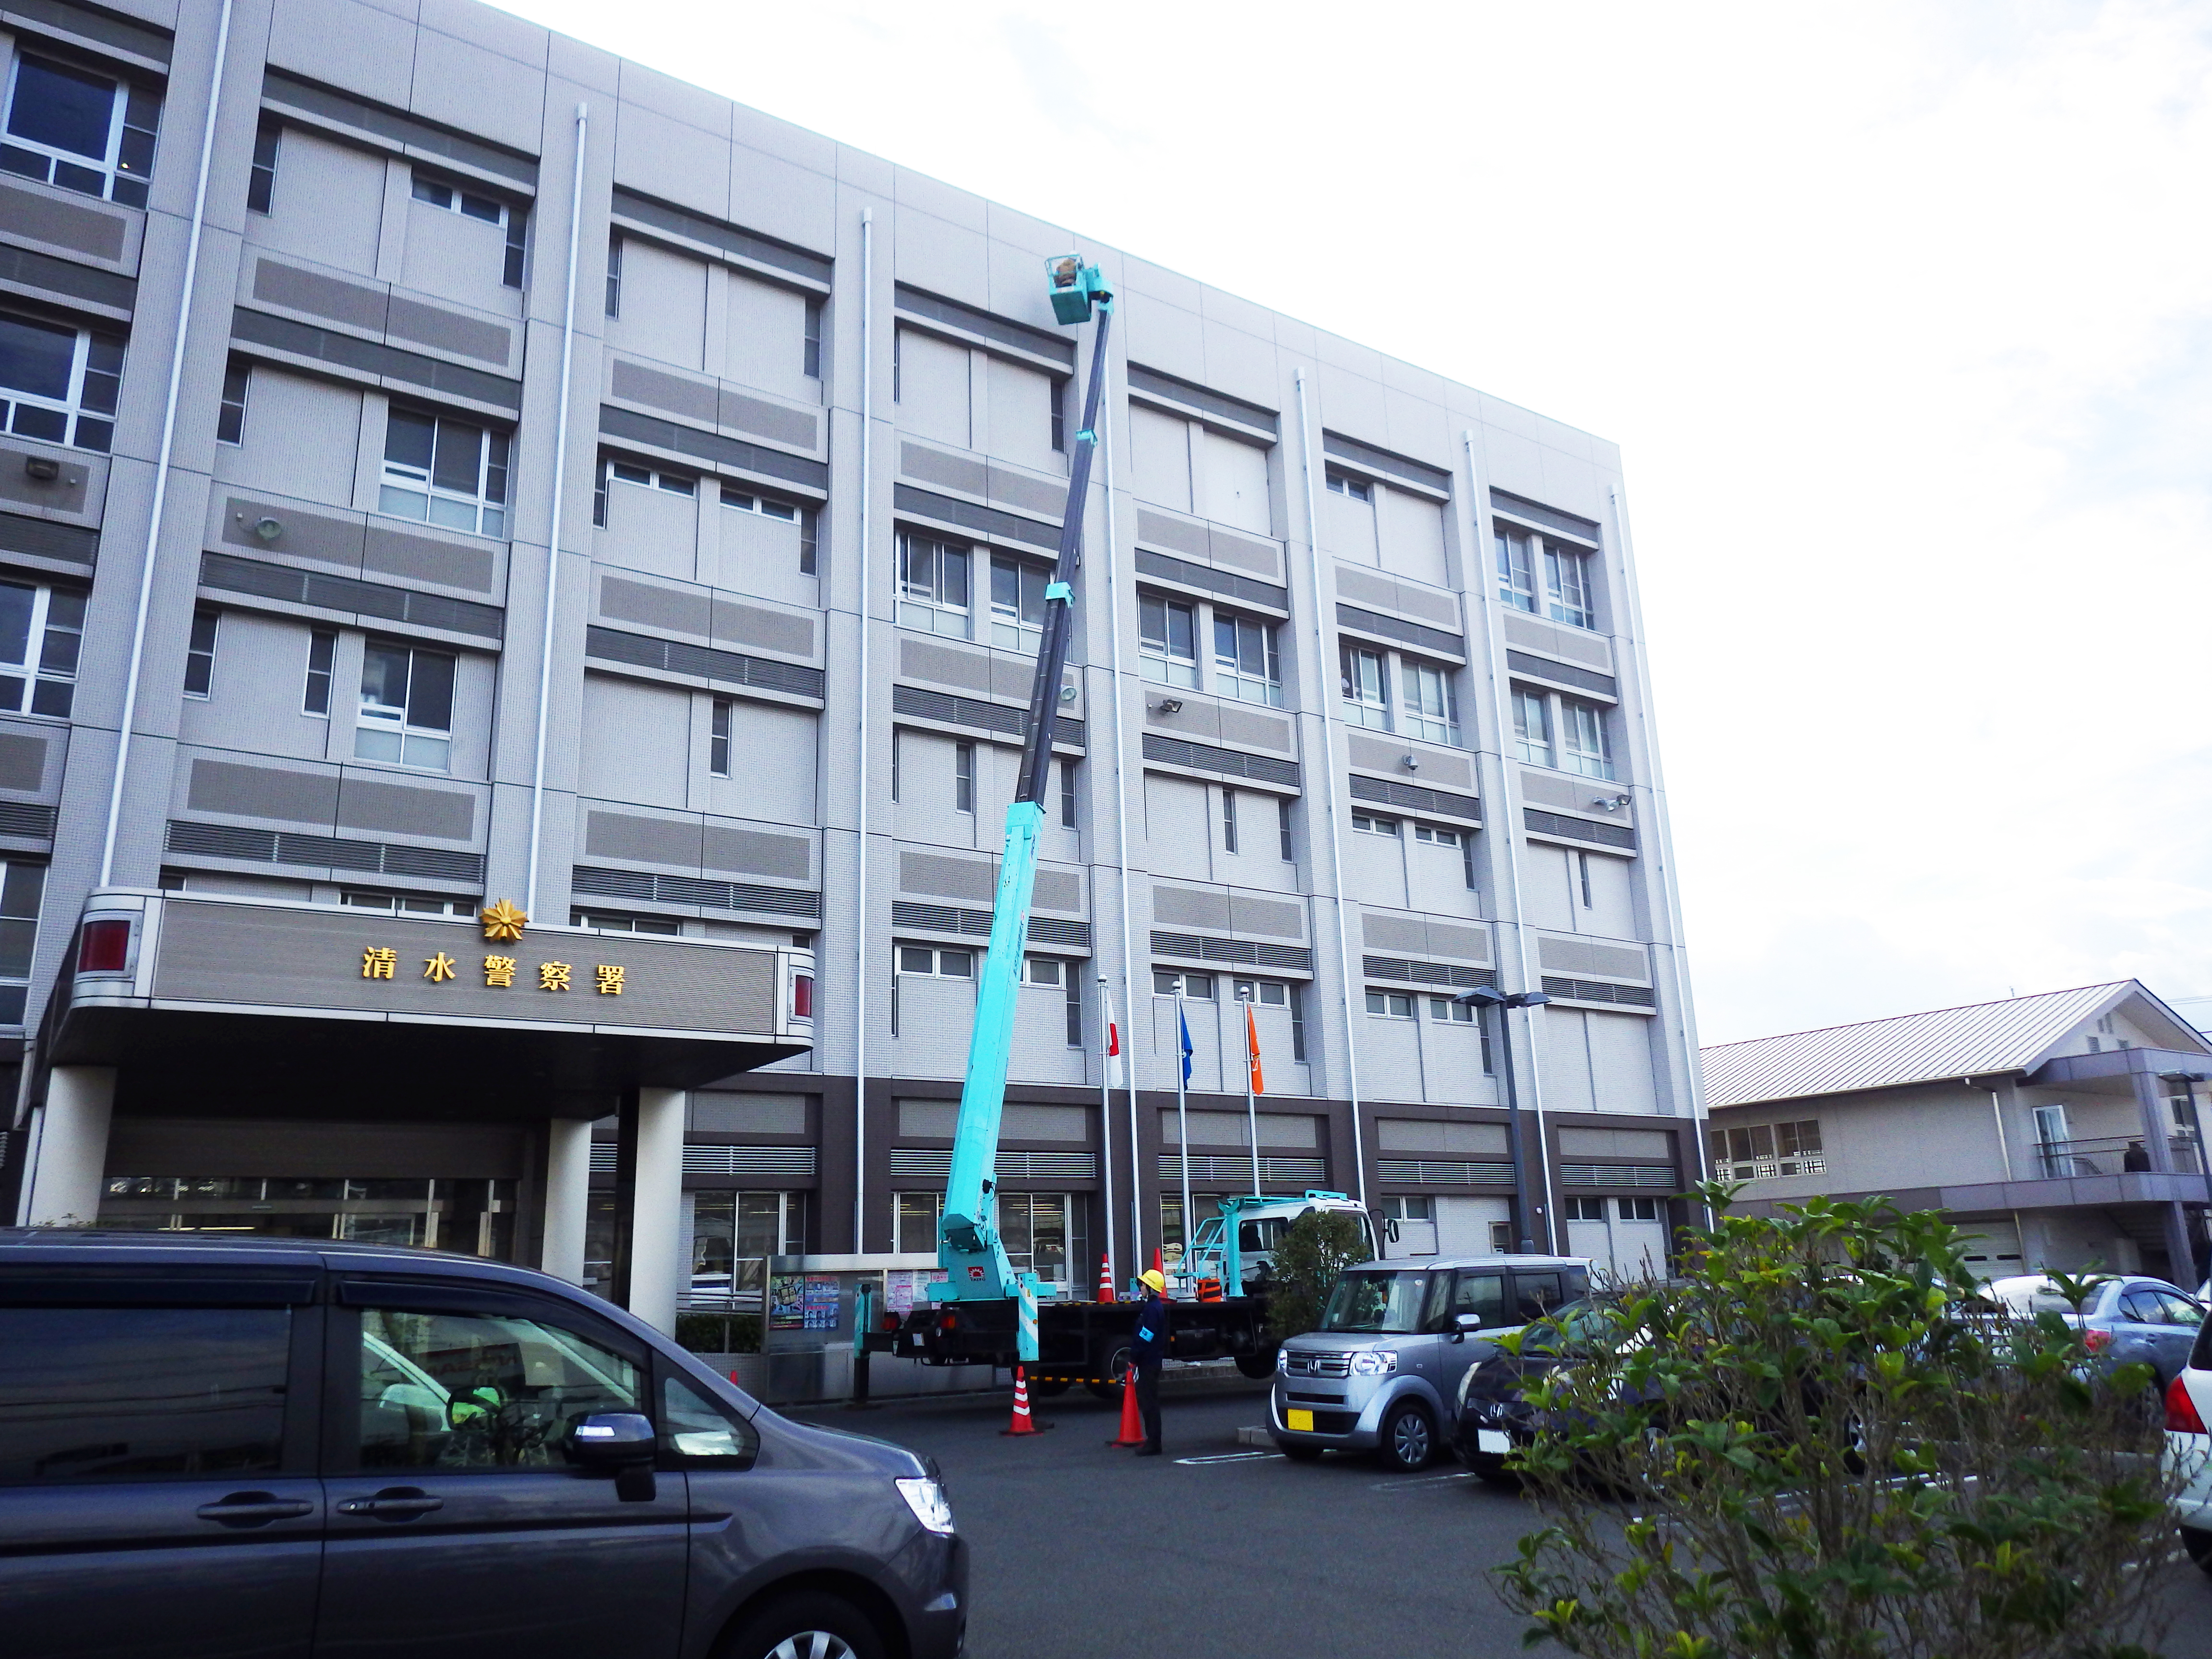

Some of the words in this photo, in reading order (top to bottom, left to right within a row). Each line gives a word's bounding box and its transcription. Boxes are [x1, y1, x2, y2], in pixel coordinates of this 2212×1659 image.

[362, 946, 625, 995] 清水警察署
